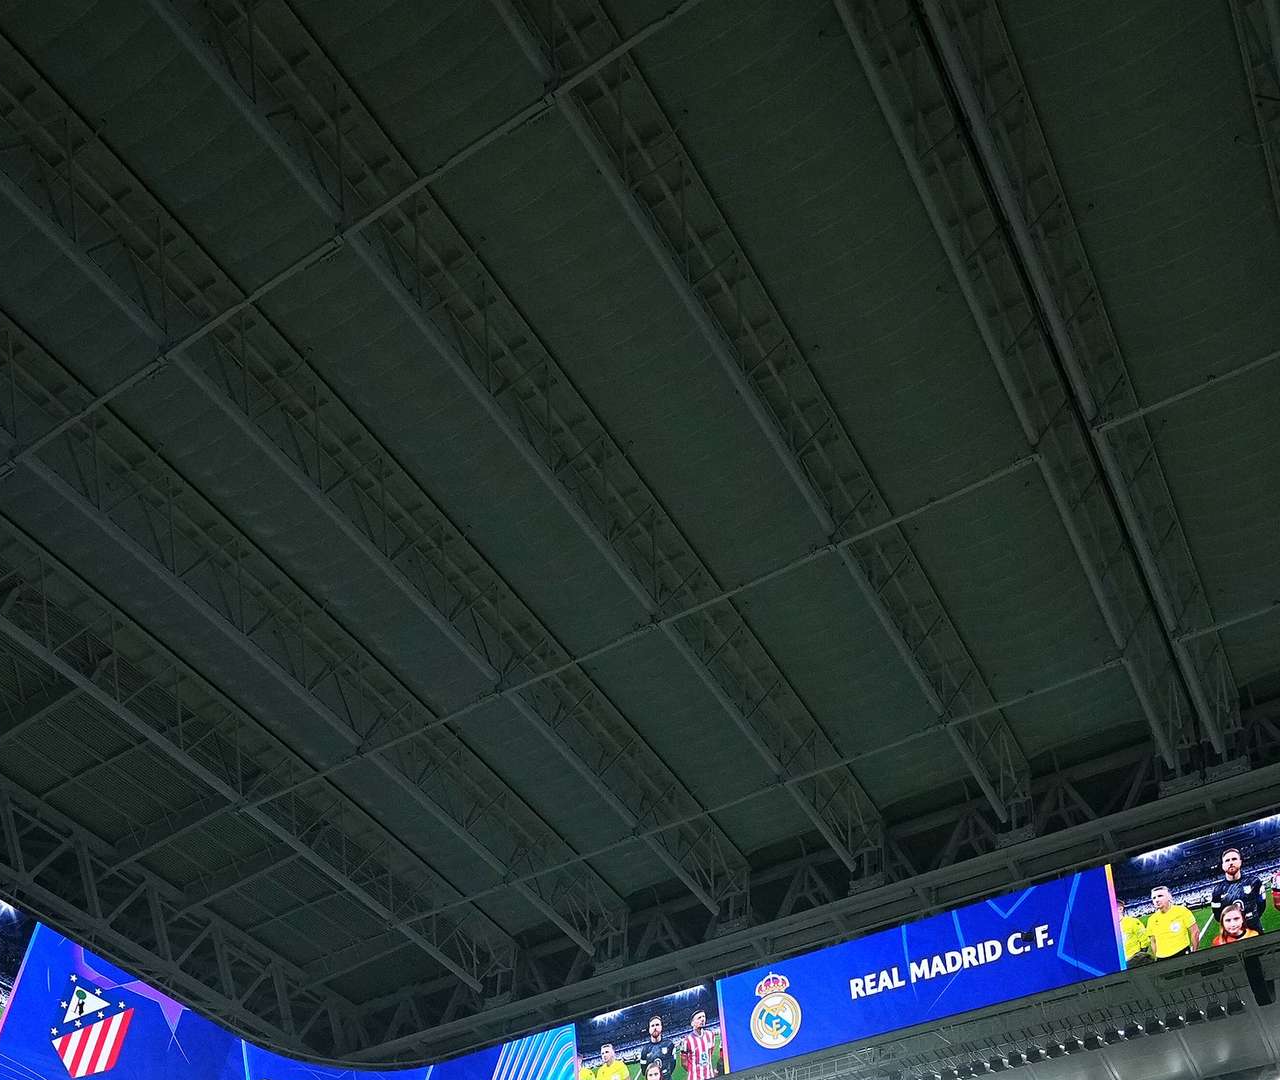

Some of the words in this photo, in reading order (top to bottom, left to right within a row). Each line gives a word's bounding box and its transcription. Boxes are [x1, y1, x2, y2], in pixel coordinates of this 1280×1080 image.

[849, 964, 906, 1000] REAL
[908, 939, 1003, 984] MADRID
[1007, 930, 1031, 956] C.
[1034, 924, 1054, 950] F.
